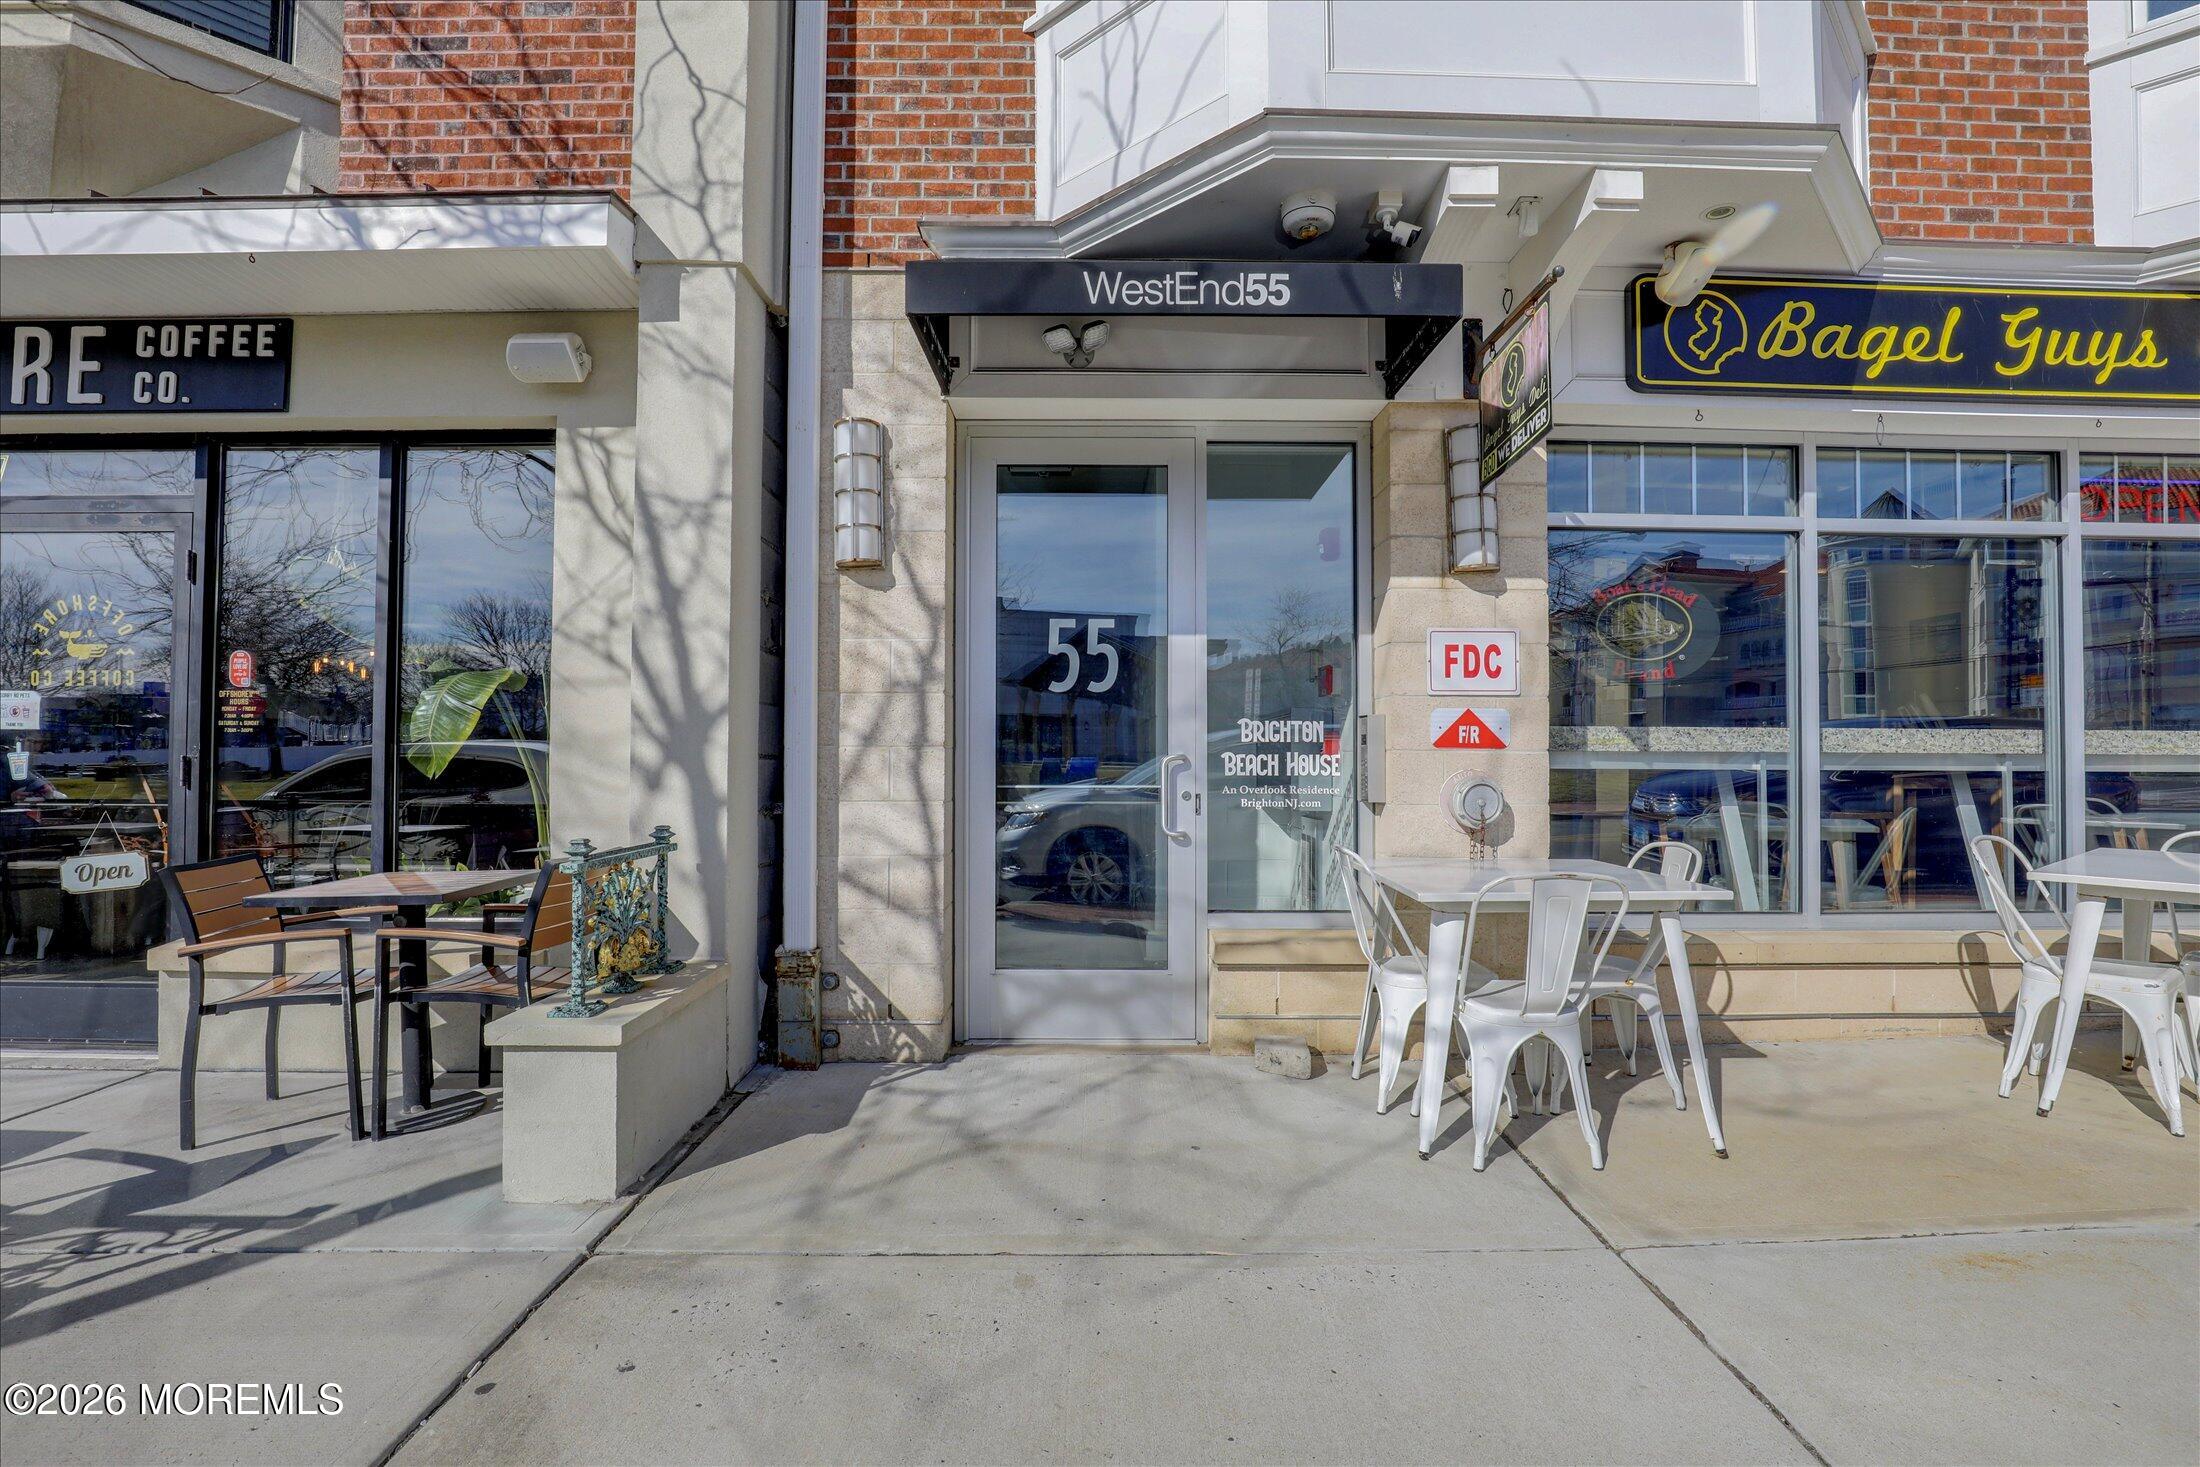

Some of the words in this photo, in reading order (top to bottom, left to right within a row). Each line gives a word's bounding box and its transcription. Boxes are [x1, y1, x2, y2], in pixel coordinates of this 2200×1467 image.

[1083, 271, 1291, 306] WestEnd55
[136, 324, 275, 358] COFFEE
[1757, 300, 1964, 379] Bagel
[1994, 307, 2168, 385] Guys
[10, 326, 106, 405] RE
[133, 371, 190, 404] CO.
[1529, 375, 1547, 405] Deli
[1498, 443, 1511, 464] WE
[1511, 406, 1547, 453] DELIVER
[1048, 618, 1119, 693] 55
[1444, 643, 1502, 679] FDC
[1237, 718, 1325, 743] BRIGHTON
[1458, 726, 1480, 744] F/R
[1220, 752, 1279, 776] BEACH
[1286, 752, 1341, 776] HOUSE
[1222, 785, 1237, 795] An
[1239, 784, 1287, 795] Overlook
[1290, 784, 1340, 795] Residence
[1241, 798, 1321, 810] BrightonNJ.com
[75, 863, 134, 888] Open
